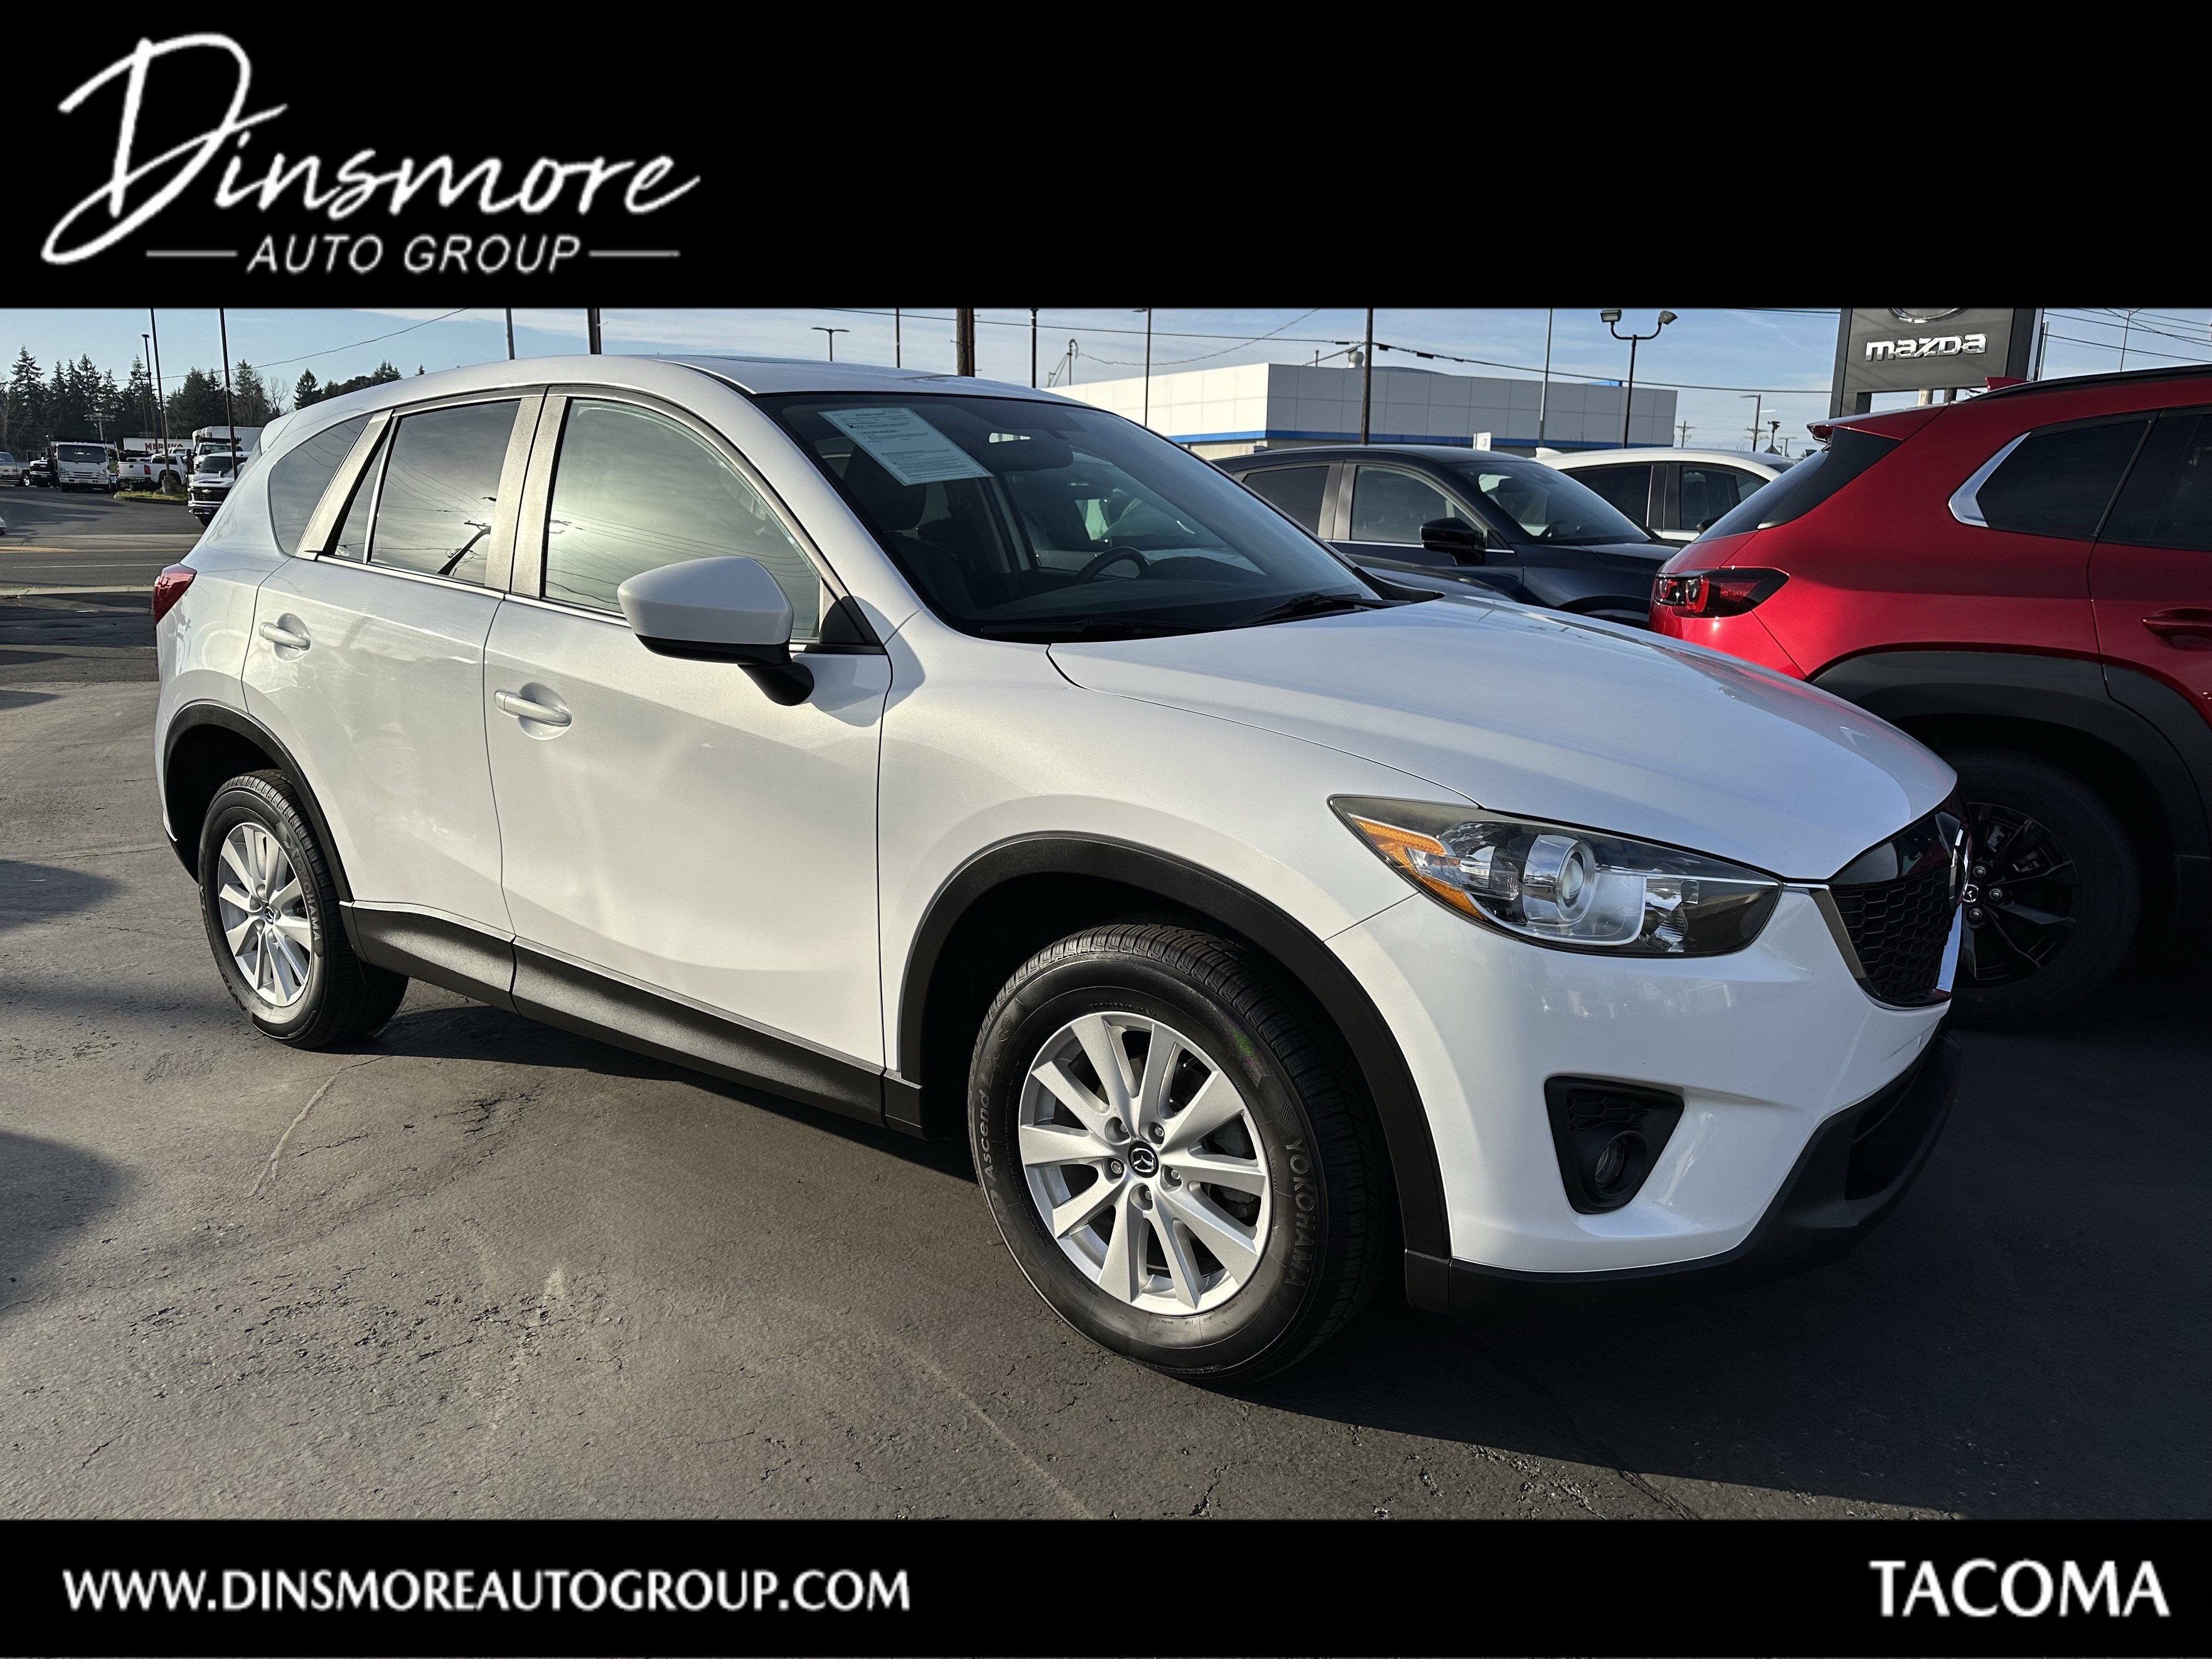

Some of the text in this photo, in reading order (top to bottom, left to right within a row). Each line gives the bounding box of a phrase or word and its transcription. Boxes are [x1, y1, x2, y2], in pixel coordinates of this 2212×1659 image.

[290, 850, 321, 941] YOKOHAMA
[979, 1089, 998, 1181] Ascend
[1284, 1137, 1317, 1288] YOKOHAMA
